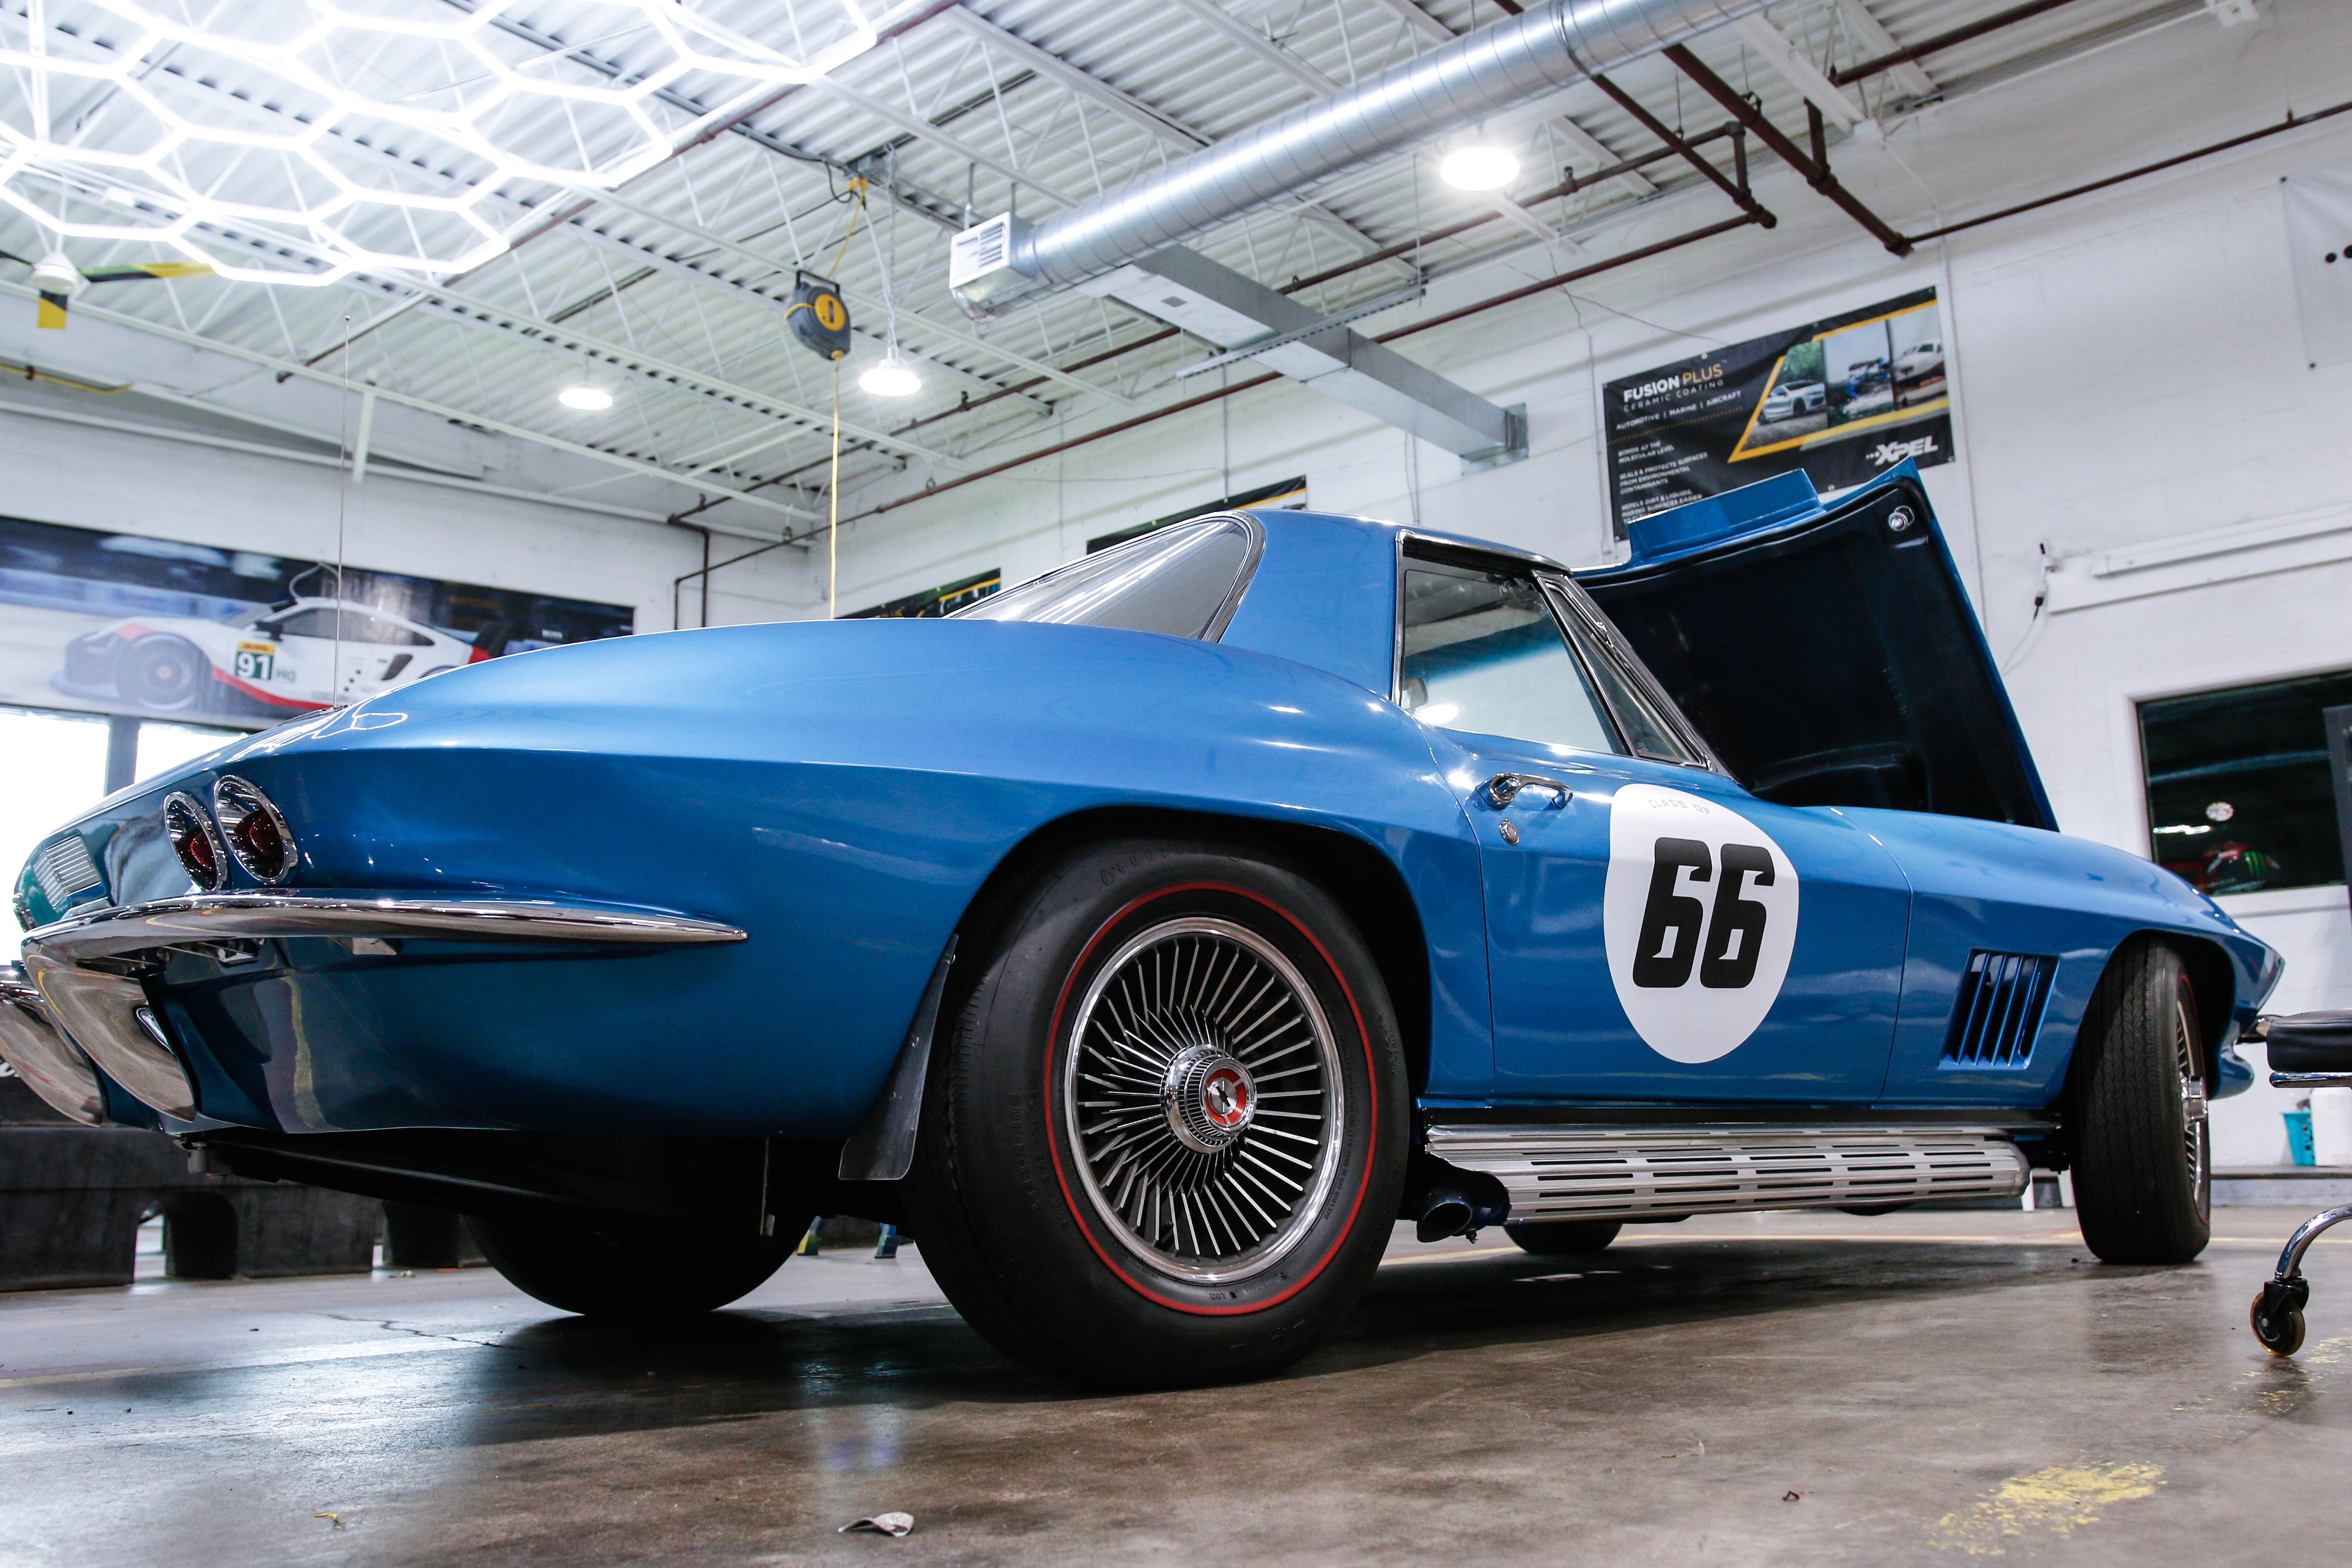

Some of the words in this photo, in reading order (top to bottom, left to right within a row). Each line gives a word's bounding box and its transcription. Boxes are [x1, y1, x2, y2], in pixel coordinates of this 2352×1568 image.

[1623, 375, 1680, 403] FUSION
[1682, 364, 1723, 386] PLUS
[1624, 394, 1671, 412] CERAMIC
[1676, 379, 1724, 399] COATING
[1616, 413, 1660, 430] AUTOMOTIVE
[1669, 404, 1697, 416] MARINE
[1706, 390, 1741, 407] AIRCRAFT
[1874, 435, 1939, 466] XPEL
[237, 653, 272, 680] 91
[1649, 799, 1687, 808] CLASS
[1633, 837, 1775, 988] 66
